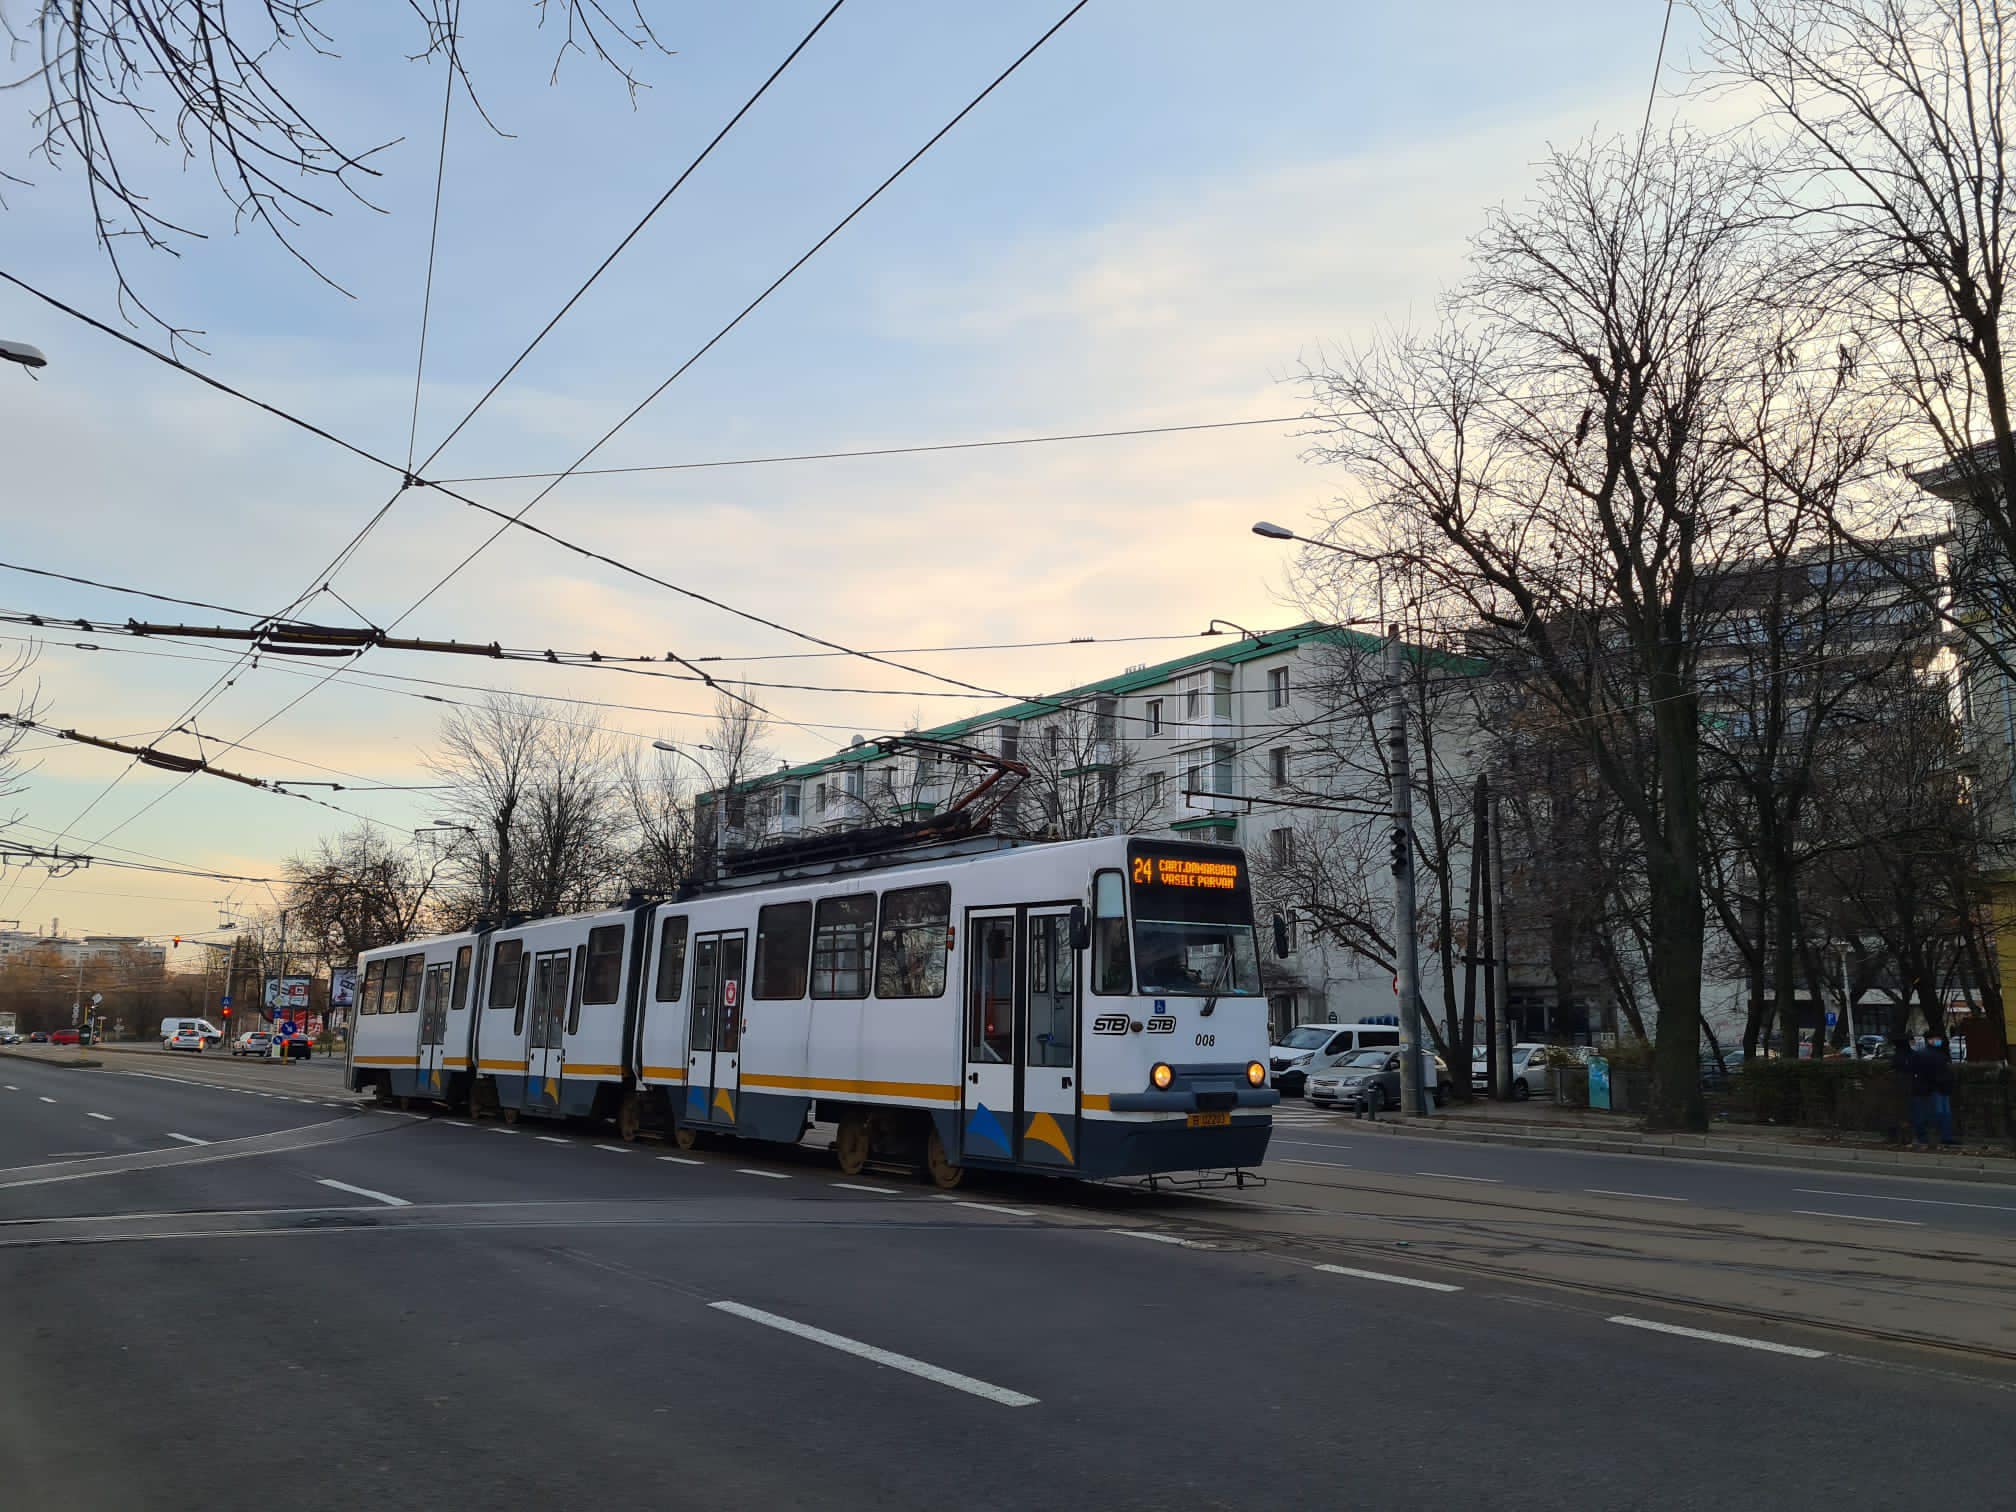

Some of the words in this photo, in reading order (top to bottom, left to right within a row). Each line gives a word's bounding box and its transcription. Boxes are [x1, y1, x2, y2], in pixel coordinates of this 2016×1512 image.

[1134, 857, 1152, 884] 24
[1161, 873, 1195, 887] VASILE
[1198, 876, 1234, 889] PARVAN
[1093, 1017, 1127, 1031] STB
[1147, 1018, 1173, 1031] STB
[1195, 1034, 1215, 1047] 008
